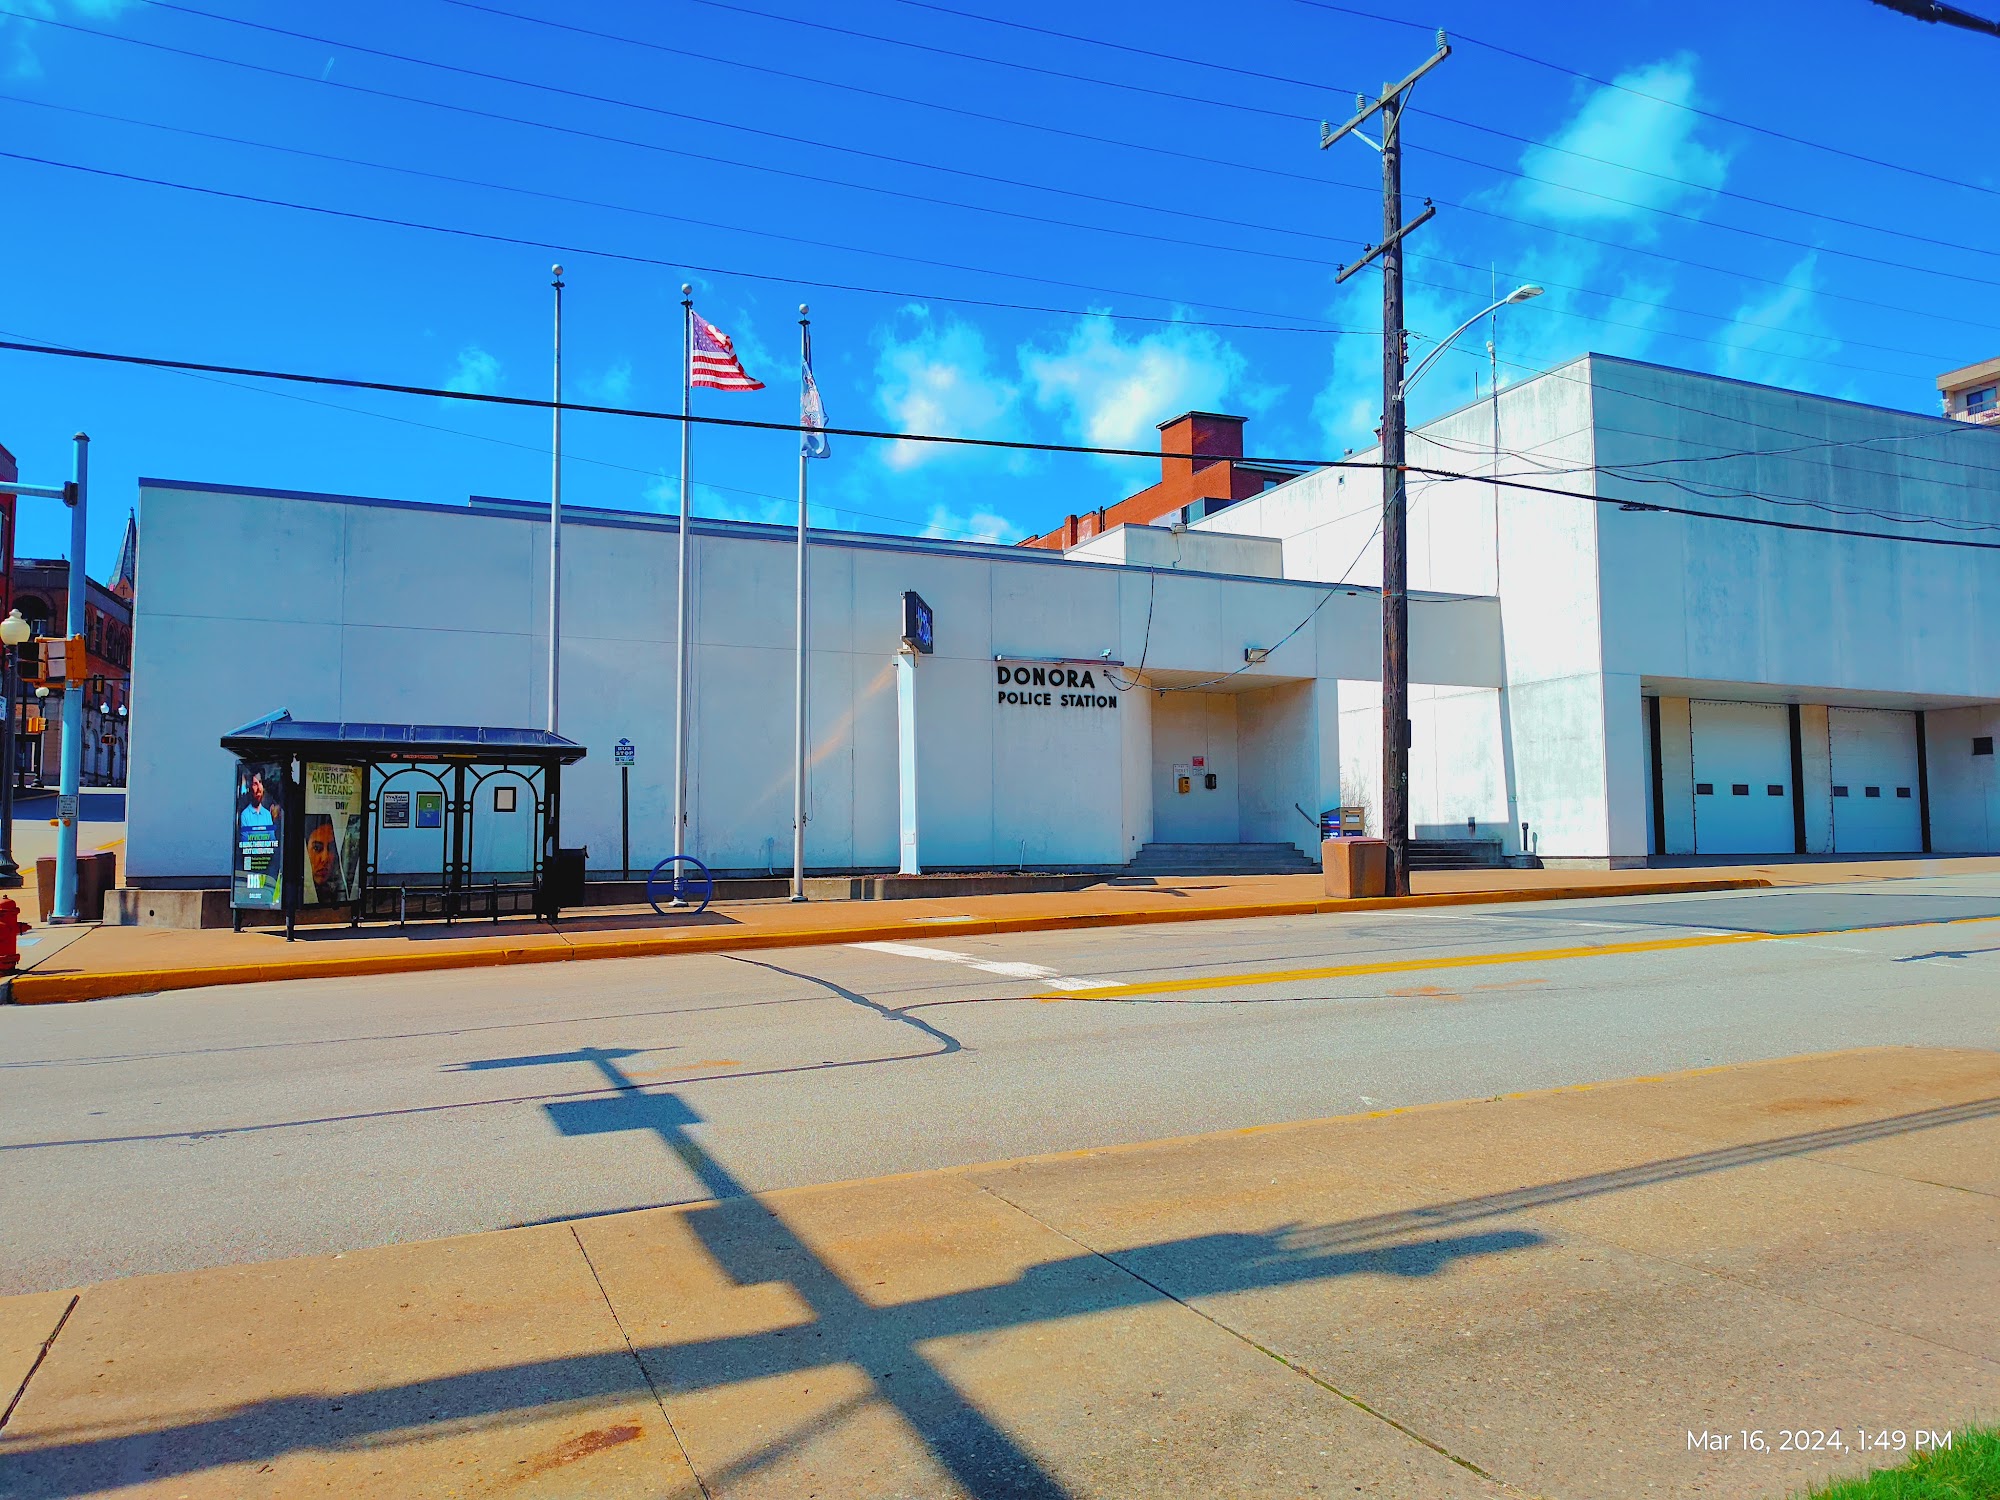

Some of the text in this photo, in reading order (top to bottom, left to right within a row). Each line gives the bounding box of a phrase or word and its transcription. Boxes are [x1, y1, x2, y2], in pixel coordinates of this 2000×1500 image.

[997, 666, 1095, 688] DONORA
[998, 691, 1117, 708] POLICE STATION
[312, 772, 355, 784] AMERICA'S
[313, 784, 353, 795] VETERANS
